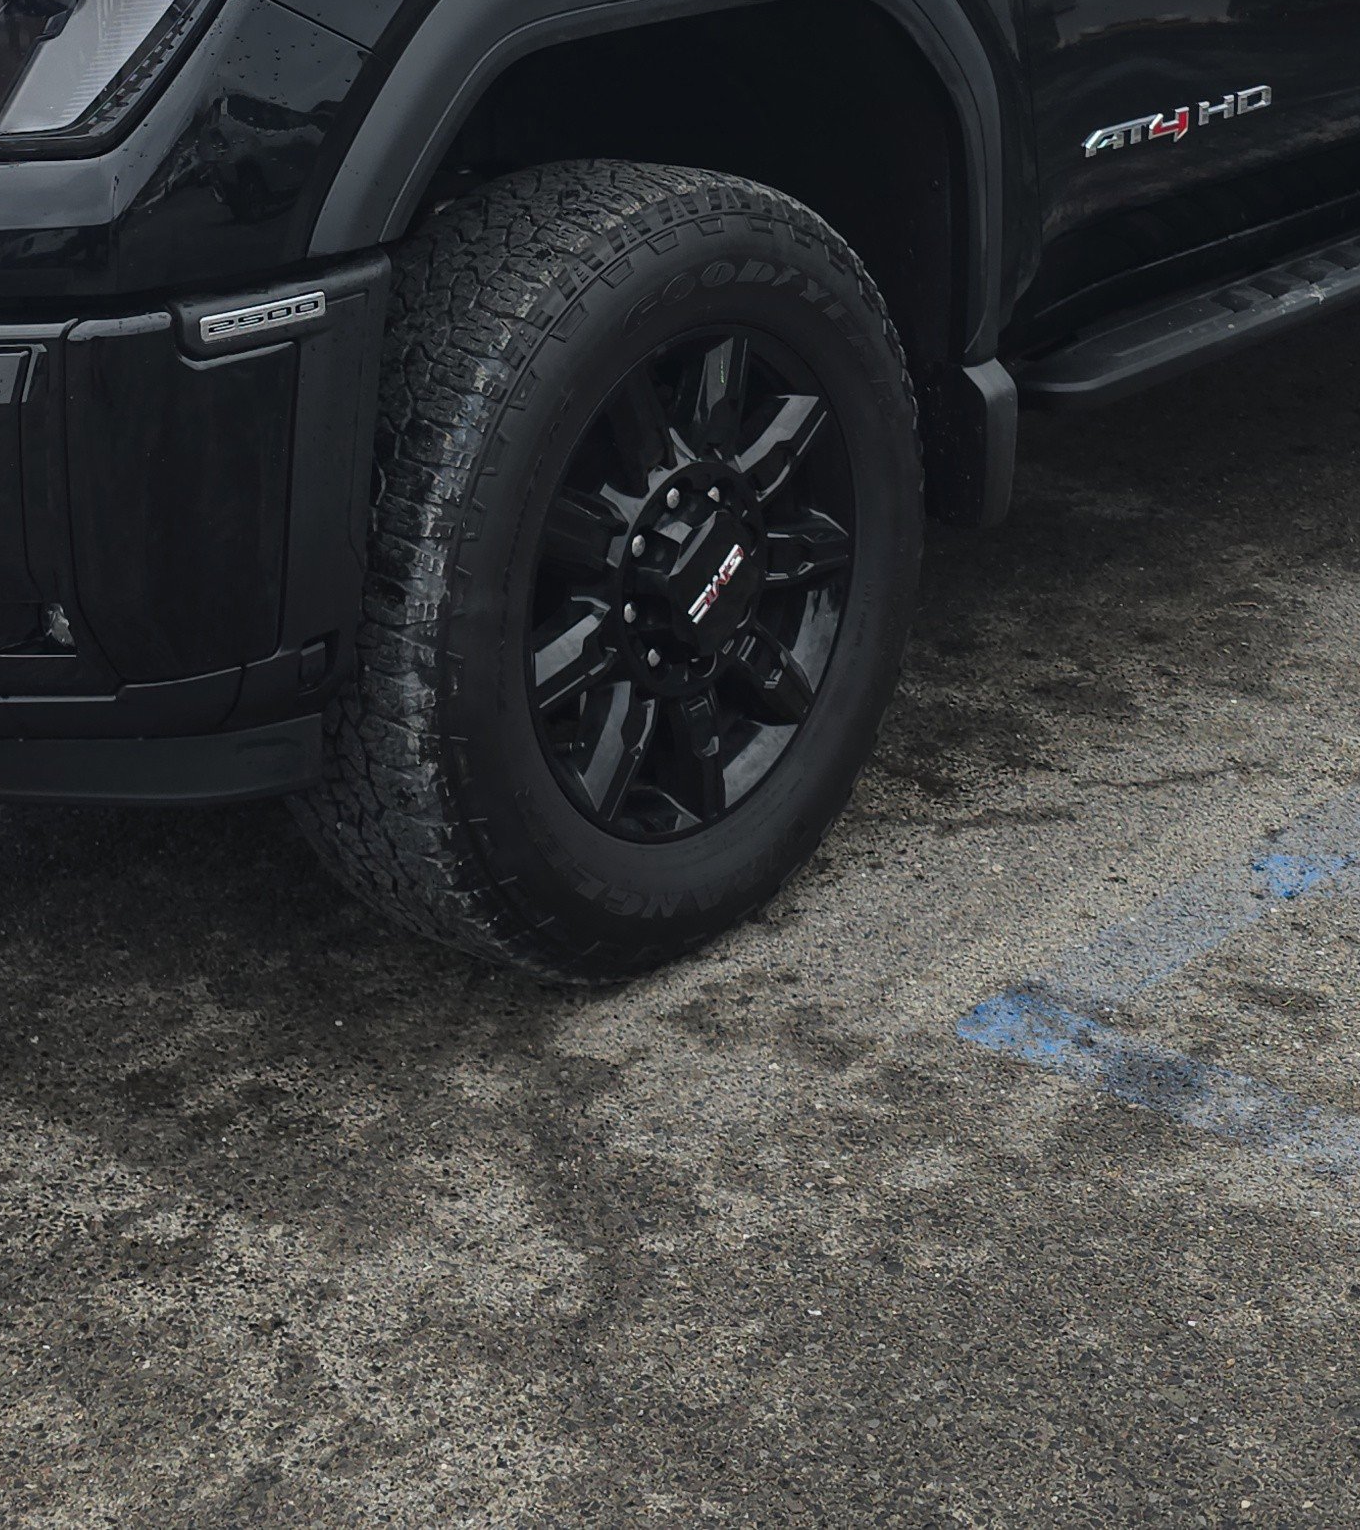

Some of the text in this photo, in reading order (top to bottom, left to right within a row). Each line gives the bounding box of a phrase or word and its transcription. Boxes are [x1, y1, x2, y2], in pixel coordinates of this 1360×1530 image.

[1081, 84, 1273, 158] AT4 HD
[208, 299, 319, 337] 2500
